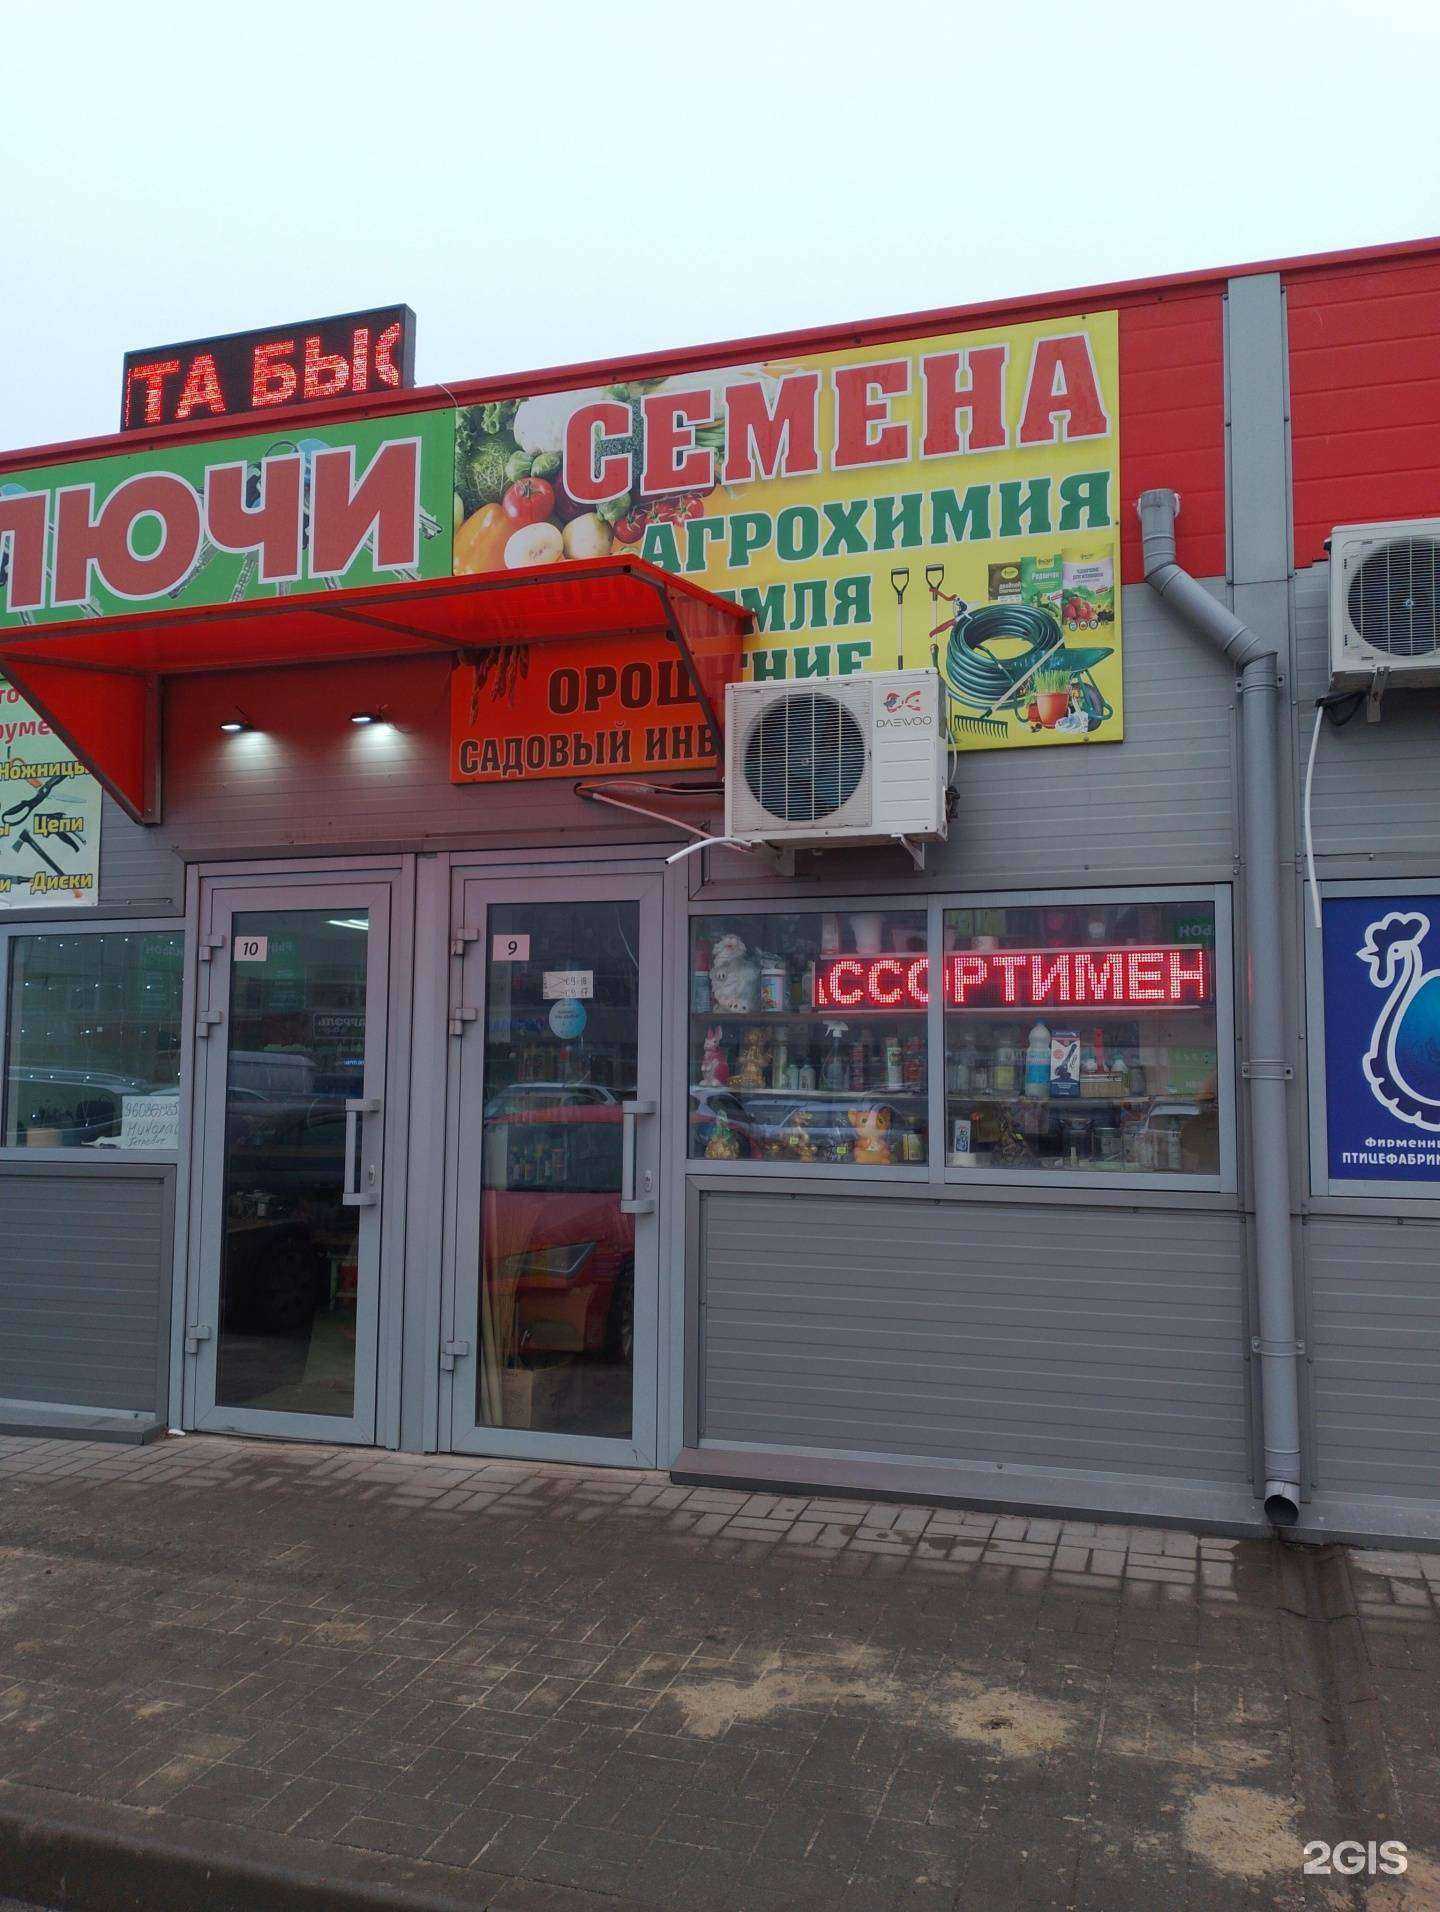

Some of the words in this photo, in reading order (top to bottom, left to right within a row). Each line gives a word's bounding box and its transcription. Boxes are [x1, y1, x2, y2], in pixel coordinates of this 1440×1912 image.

[128, 354, 227, 427] ТА
[562, 332, 1111, 504] СЕМЕНА
[640, 470, 1112, 573] АГРОХИМИЯ
[713, 574, 872, 634] МЛЯ
[458, 720, 632, 777] САДОВЫЙ
[644, 723, 720, 762] ИНВ
[876, 715, 932, 728] DAEWOO
[33, 816, 85, 838] Цепи
[30, 871, 94, 896] Диски
[243, 941, 259, 957] 10
[507, 939, 518, 956] 9
[818, 951, 1205, 1005] ССОРТИМЕН
